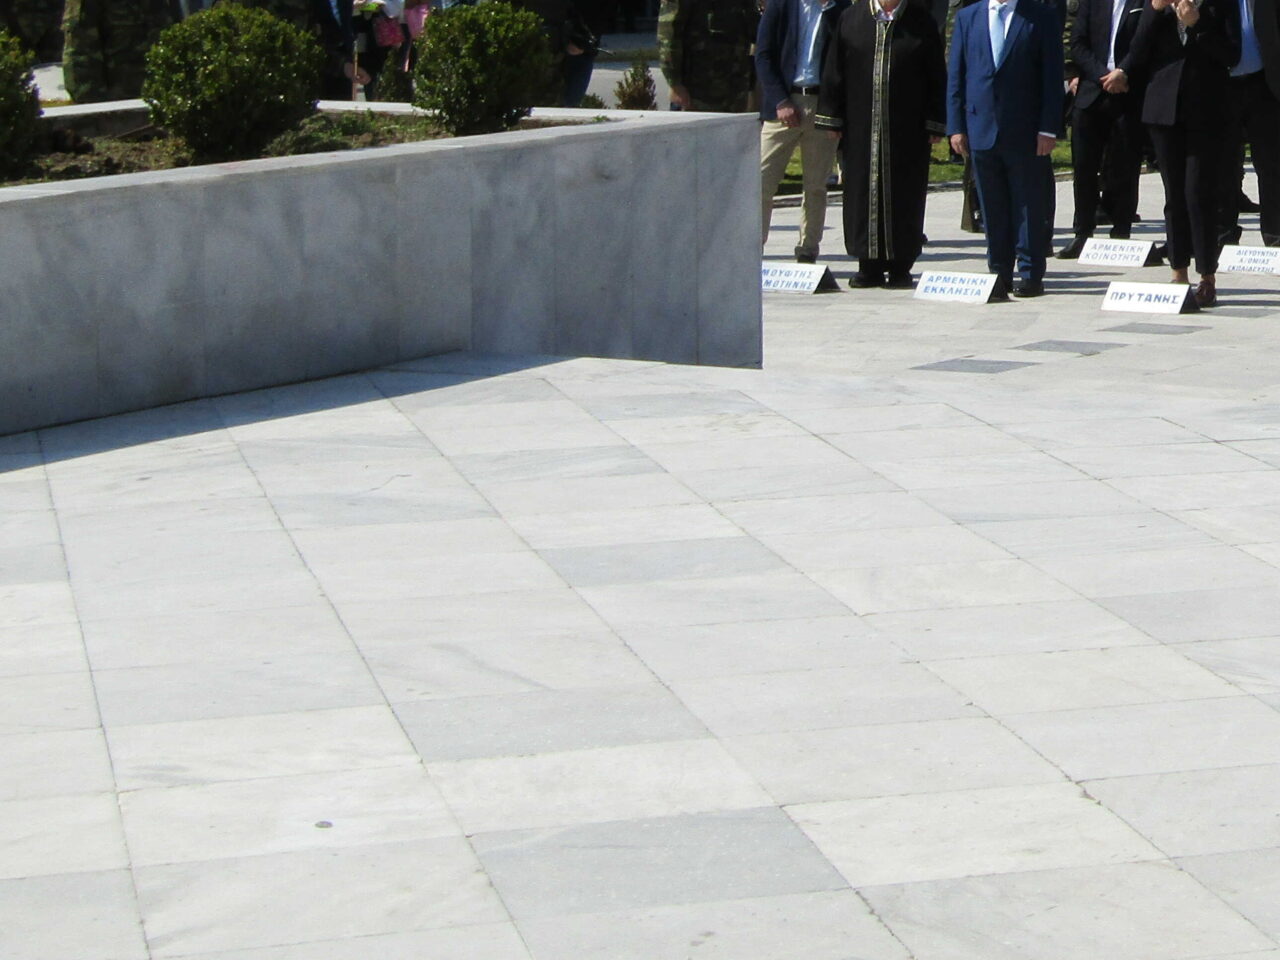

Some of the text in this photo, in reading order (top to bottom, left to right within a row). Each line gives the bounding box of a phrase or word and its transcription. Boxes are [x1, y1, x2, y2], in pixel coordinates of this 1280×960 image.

[1085, 252, 1140, 262] ΚΟΙΝΟΤΗΤΑ
[763, 279, 814, 290] ΜΟΤΗΝΗΣ
[926, 274, 989, 286] ΑΡΜΕΝΙΚΗ
[923, 285, 983, 297] ΕΚΚΛΗΣΙΑ
[1109, 291, 1183, 305] ΠΡΥΤΑΝΗΣ
